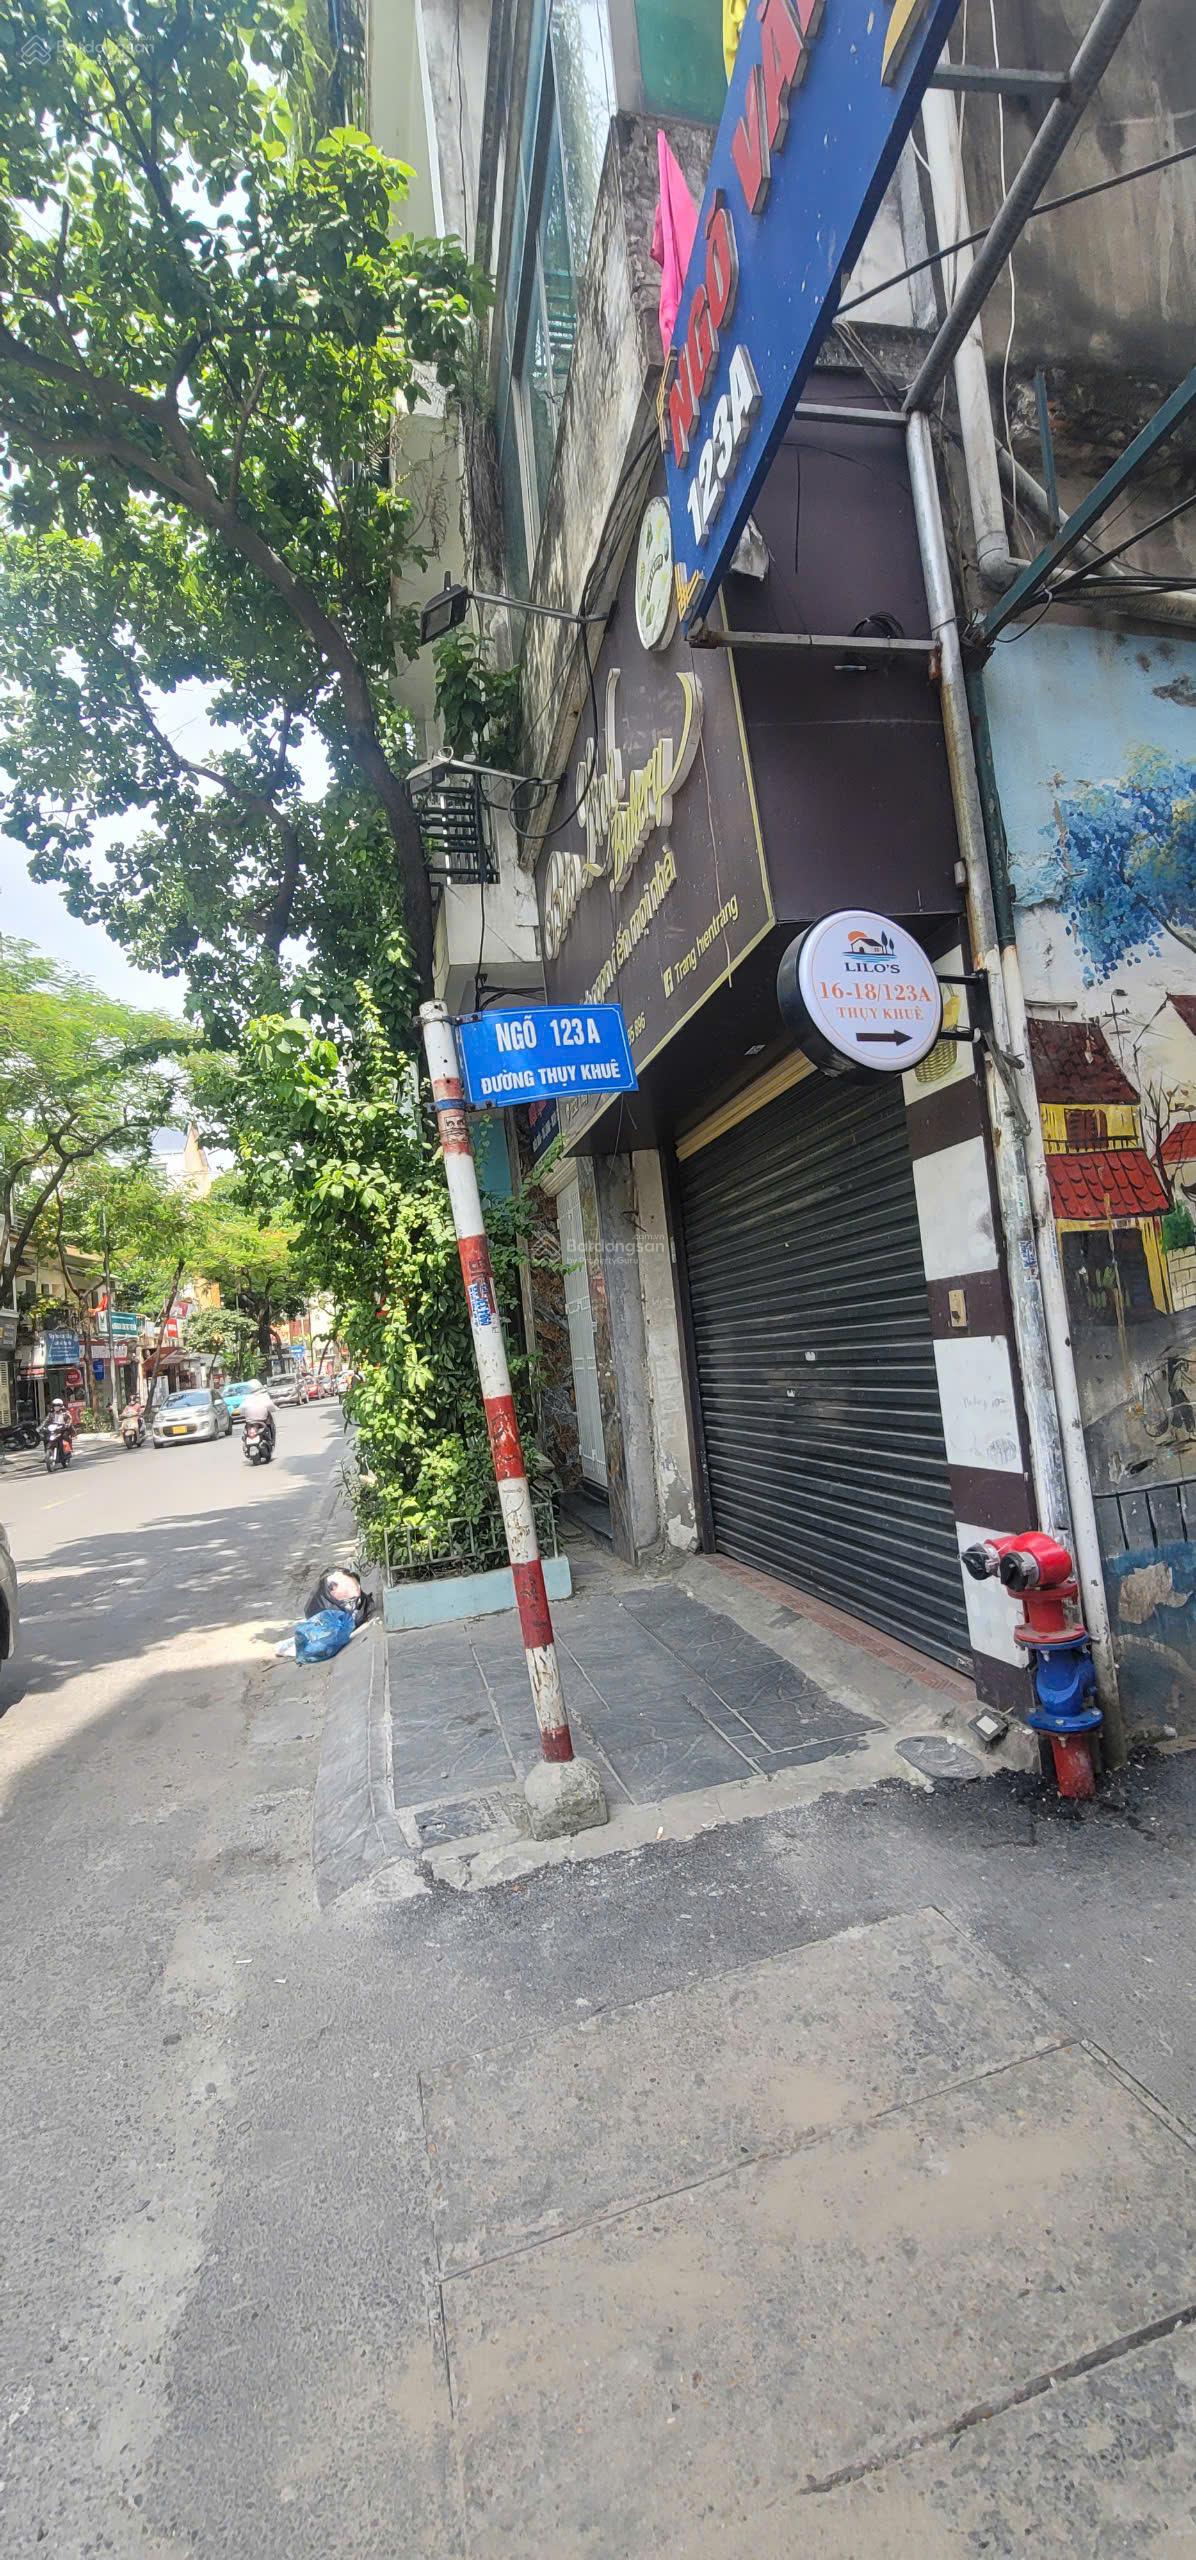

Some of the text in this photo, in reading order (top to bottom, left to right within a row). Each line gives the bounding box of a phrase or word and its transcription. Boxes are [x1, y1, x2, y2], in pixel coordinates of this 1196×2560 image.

[686, 345, 762, 546] 123A
[649, 844, 678, 913] nhà
[674, 947, 698, 985] Trang
[844, 962, 901, 974] LILO'S
[820, 981, 932, 1003] 16-18/123A
[836, 1006, 925, 1023] THỤY KHUÊ
[495, 1015, 538, 1052] NGÕ
[481, 1059, 621, 1095] ĐƯỜNG THỤY KHUÊ
